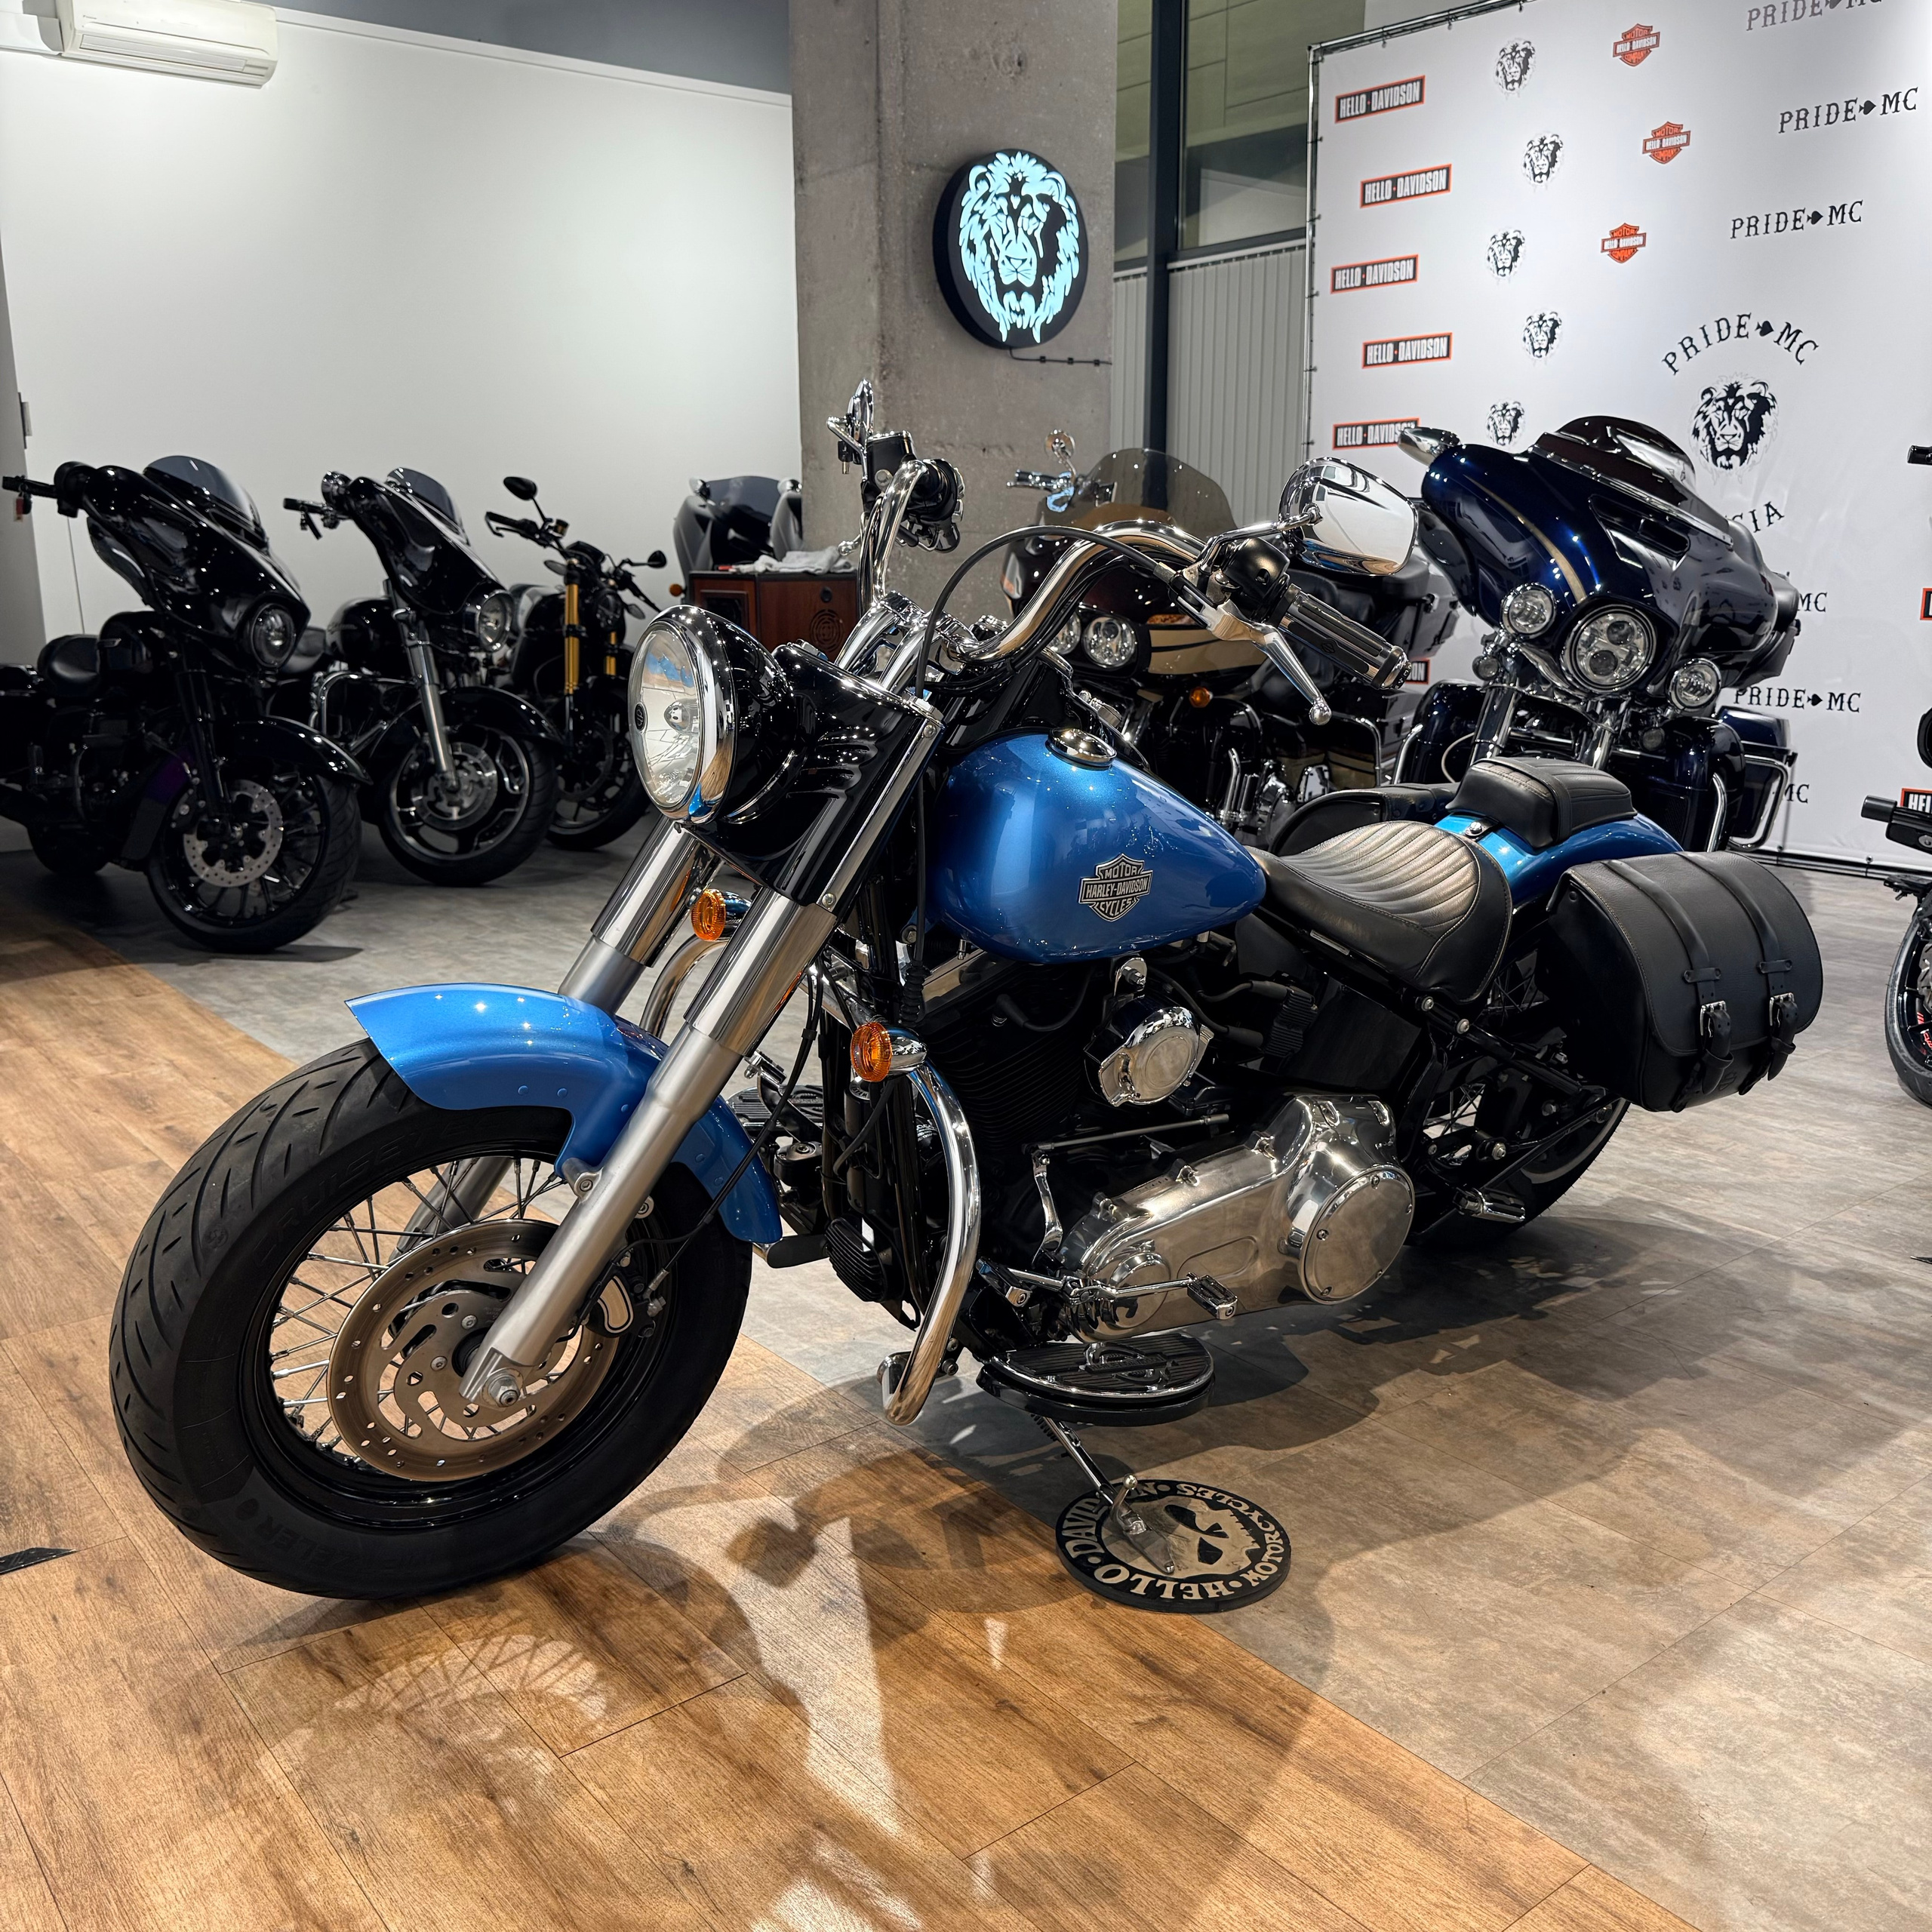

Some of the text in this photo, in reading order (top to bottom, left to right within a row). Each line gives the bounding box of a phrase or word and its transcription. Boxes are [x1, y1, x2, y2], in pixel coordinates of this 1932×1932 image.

[1746, 0, 1823, 31] PRIDE
[1626, 28, 1648, 39] MOTOR
[1340, 81, 1420, 118] HELLO DAVIDSON
[1778, 87, 1918, 134] PRIDE MC
[1656, 126, 1678, 137] MOTOR
[1364, 169, 1447, 204] HELLO DAVIDSON
[1614, 226, 1635, 237] MOTOR
[1730, 199, 1863, 239] PRIDE MC
[1335, 259, 1414, 290] HELLO DAVIDSON
[1366, 337, 1448, 365] HELLO DAVIDSON
[1661, 312, 1820, 375] PRIDE MC
[1337, 422, 1416, 446] HELLO DAVIDS
[1734, 686, 1861, 712] PRIDE MC
[1104, 862, 1137, 879] MOTOR
[1086, 878, 1148, 898] HARLEY-DAVIDSON
[1100, 898, 1132, 916] CYCLES
[1062, 1481, 1284, 1600] DAVIDN MOTORCYCLES HELLO
